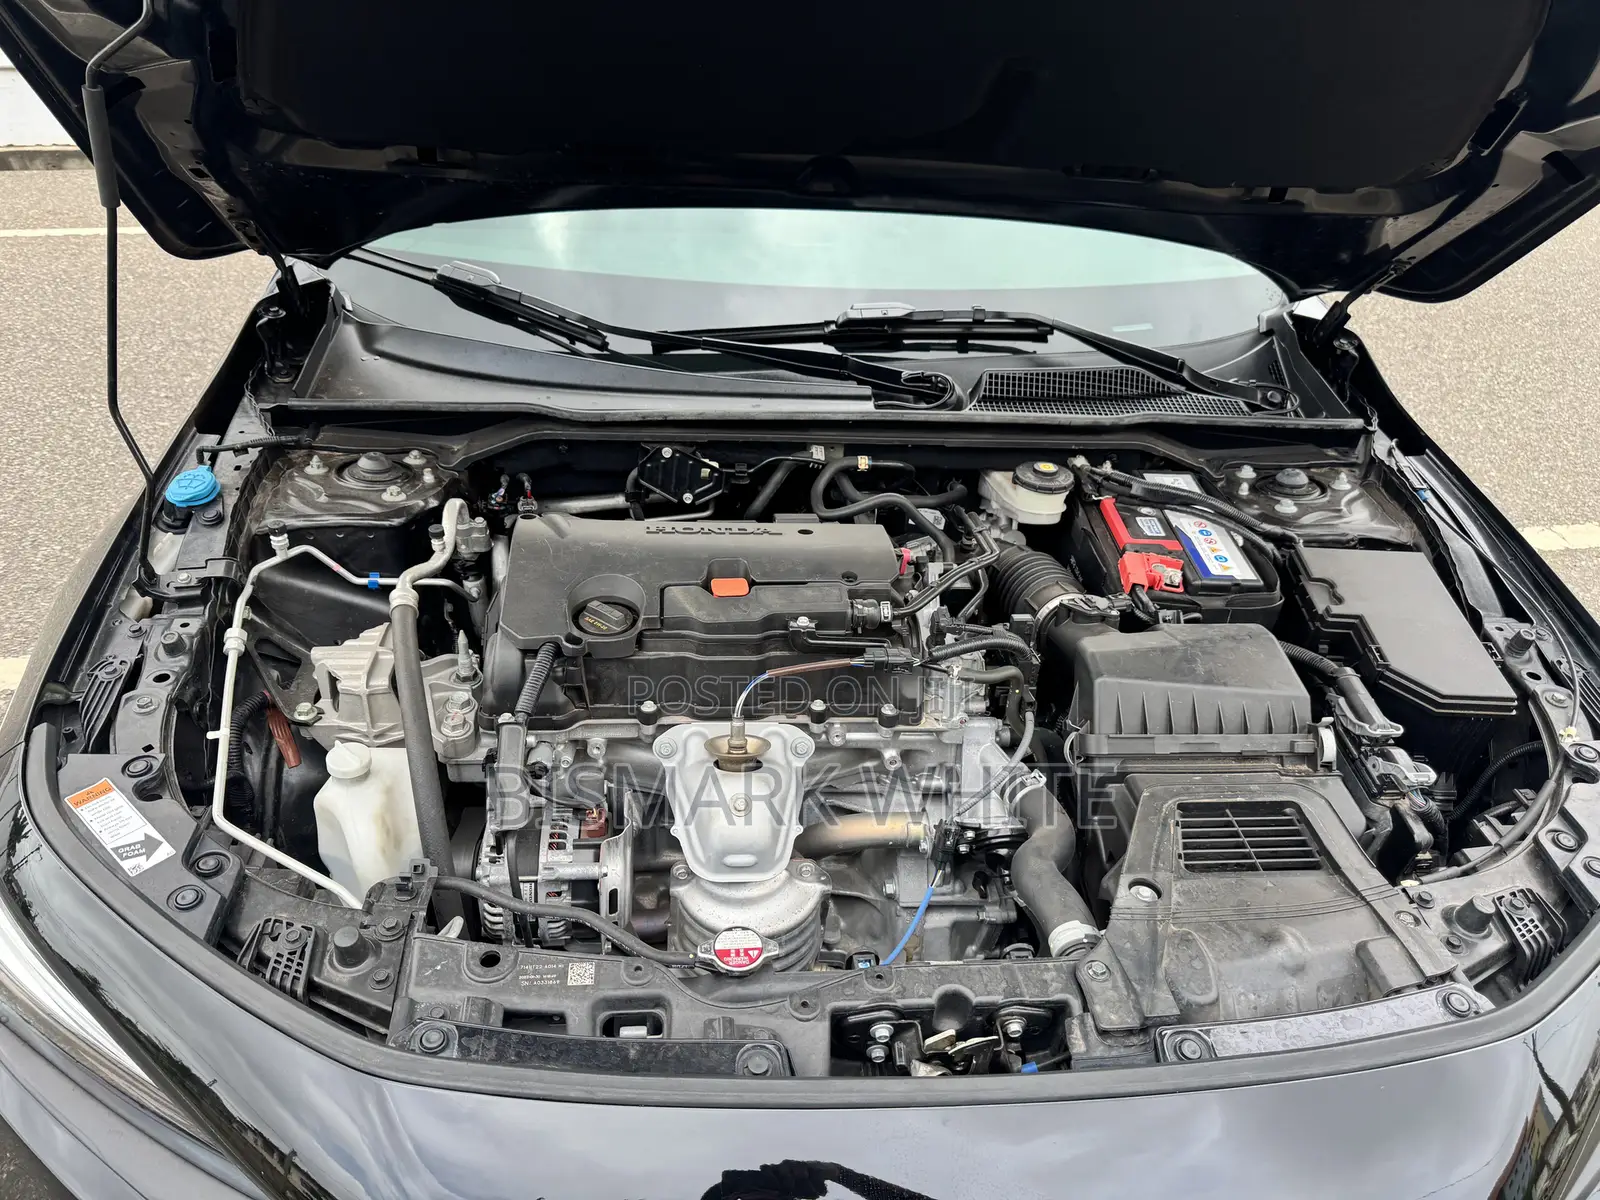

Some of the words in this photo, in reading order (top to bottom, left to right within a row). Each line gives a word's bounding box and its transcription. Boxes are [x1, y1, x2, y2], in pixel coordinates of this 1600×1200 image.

[646, 526, 783, 536] HONDA
[73, 786, 112, 807] WARNING
[118, 843, 141, 853] GRAB
[122, 848, 146, 858] FOAM
